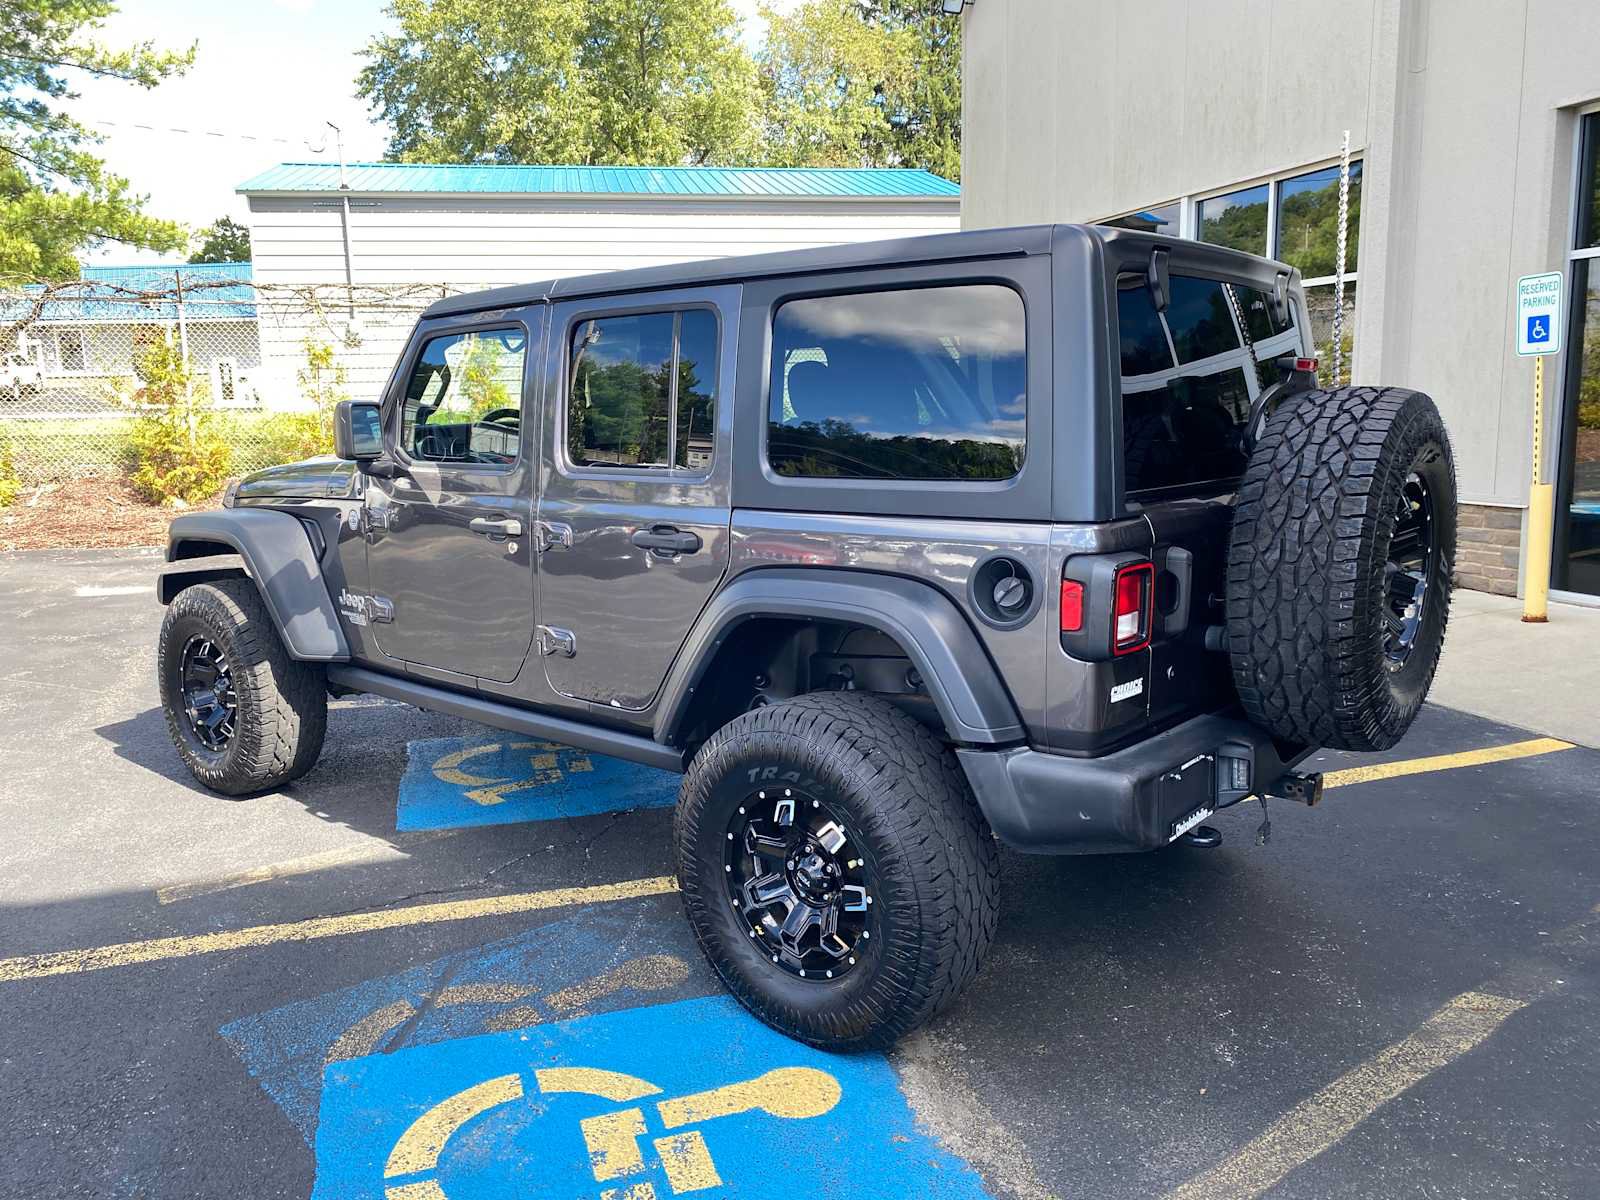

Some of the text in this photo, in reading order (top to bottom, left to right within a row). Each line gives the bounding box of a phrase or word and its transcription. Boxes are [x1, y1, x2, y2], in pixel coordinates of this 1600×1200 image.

[1521, 281, 1558, 295] RESERVED
[1523, 295, 1556, 308] PARKING
[339, 588, 364, 612] Jeep
